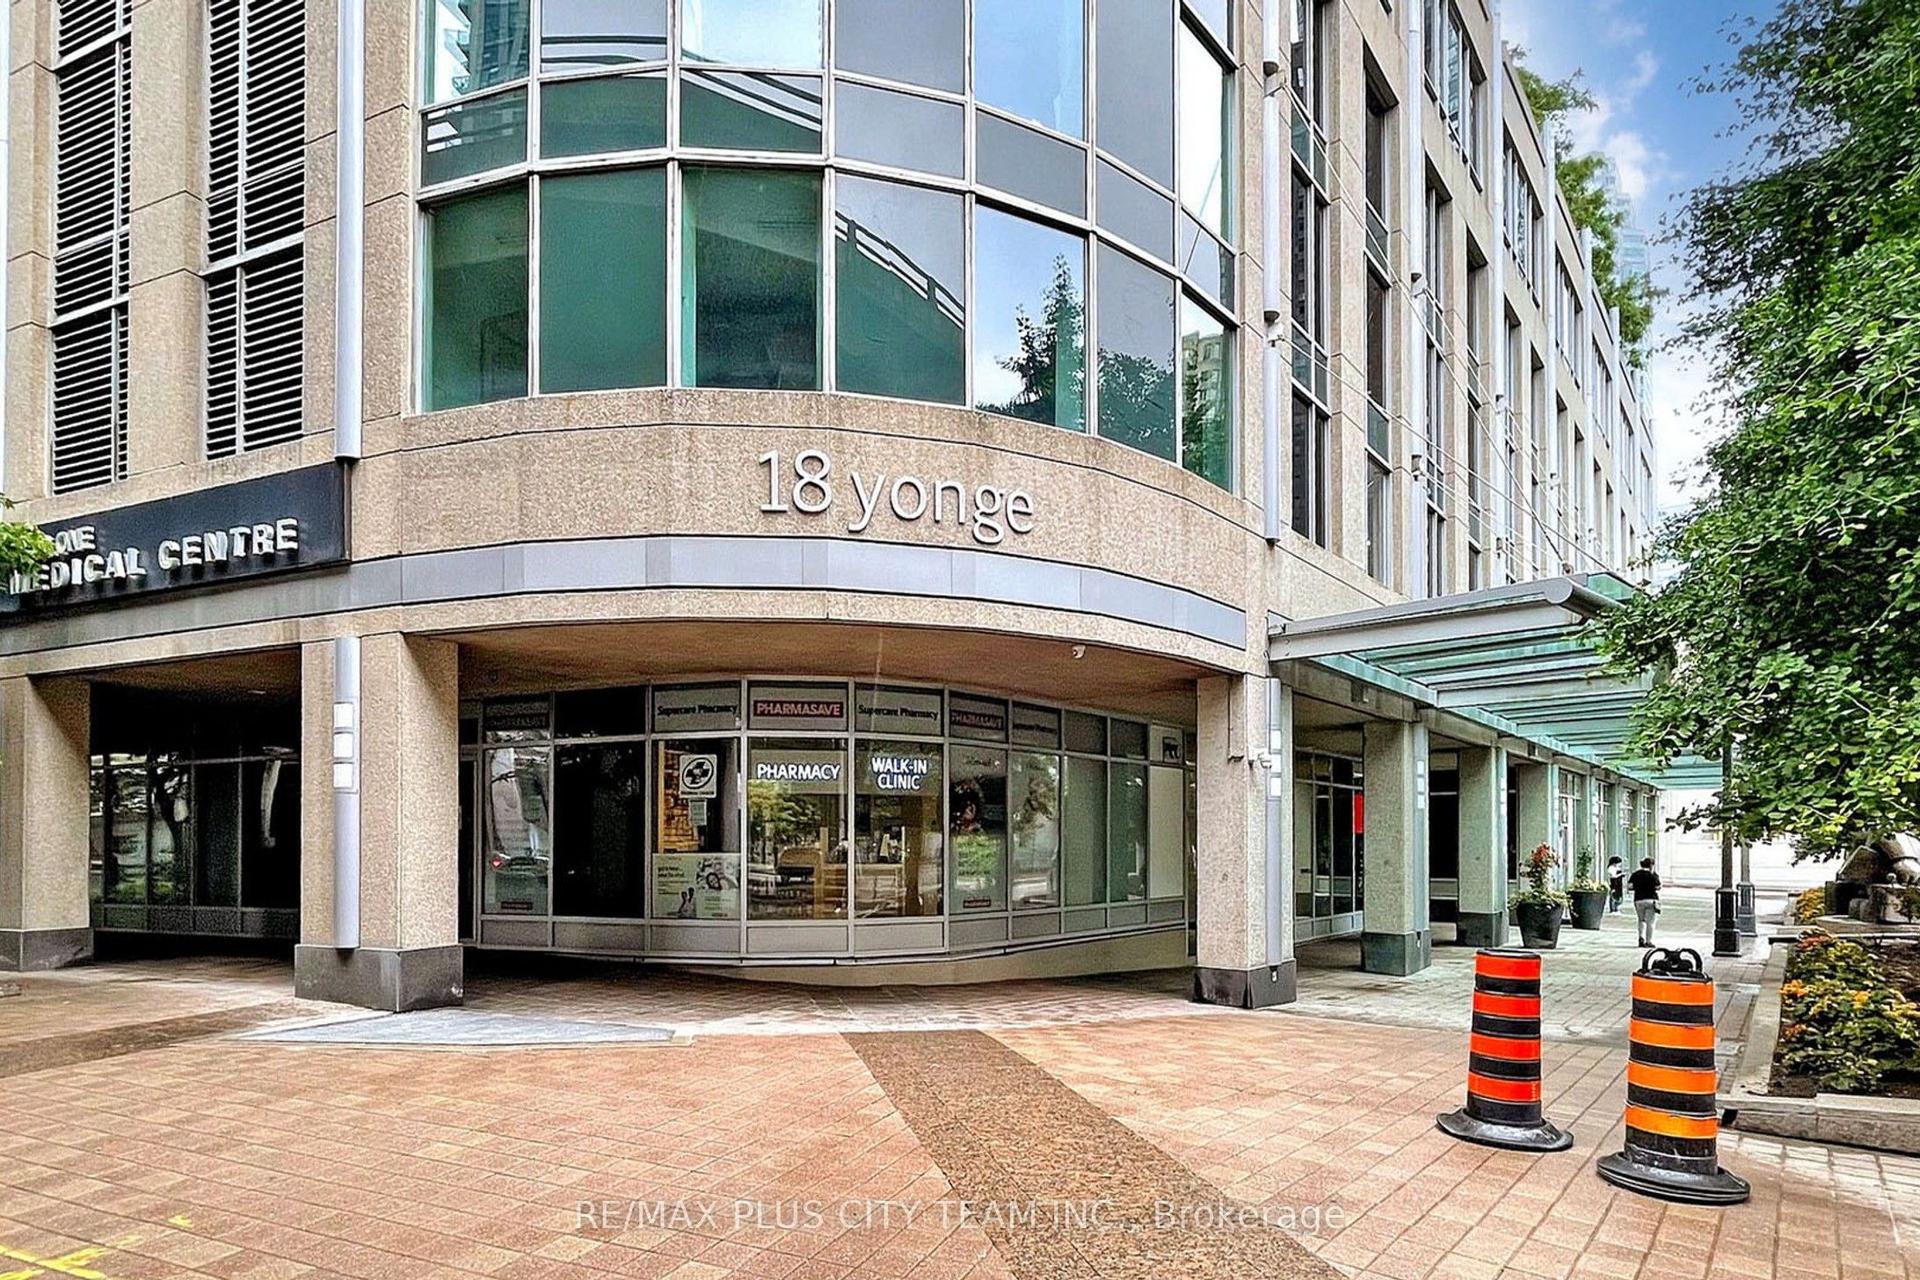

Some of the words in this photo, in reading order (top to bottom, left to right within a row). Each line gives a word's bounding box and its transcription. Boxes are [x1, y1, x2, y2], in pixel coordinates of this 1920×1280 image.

[758, 450, 832, 513] 18
[848, 471, 1034, 544] yonge
[158, 518, 299, 571] CENTRE
[756, 702, 841, 716] PHARMASAVE
[858, 704, 899, 717] Supercare
[900, 707, 938, 721] Pharmacy
[757, 763, 841, 780] PHARMACY
[871, 757, 927, 774] WALK-IN
[877, 773, 921, 790] CLINIC
